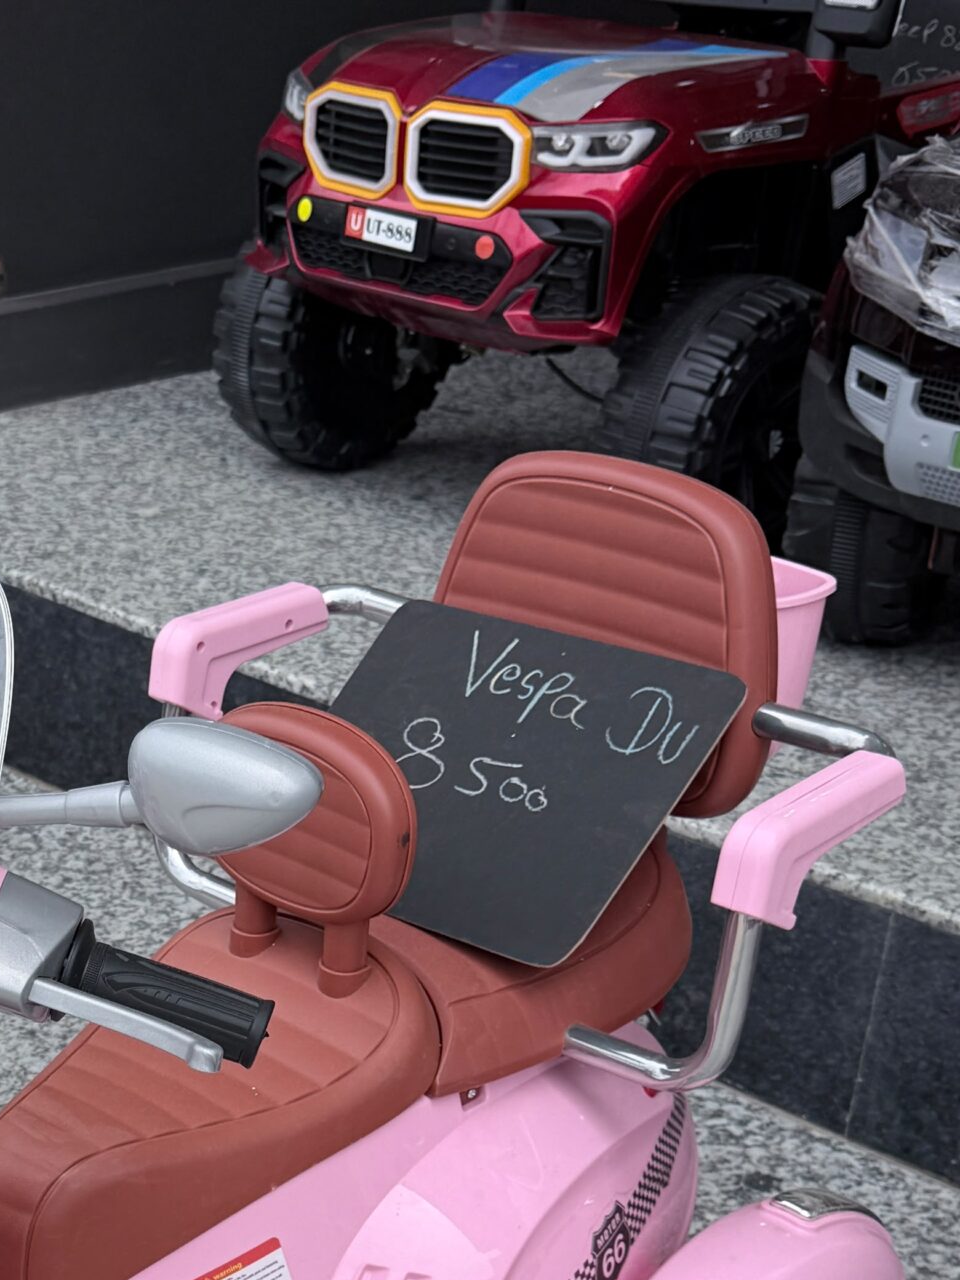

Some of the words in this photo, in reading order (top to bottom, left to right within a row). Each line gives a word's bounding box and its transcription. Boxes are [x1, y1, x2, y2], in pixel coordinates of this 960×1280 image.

[350, 211, 364, 232] U
[366, 217, 413, 244] UT-888
[464, 629, 586, 730] Vespa
[602, 1233, 626, 1279] 66
